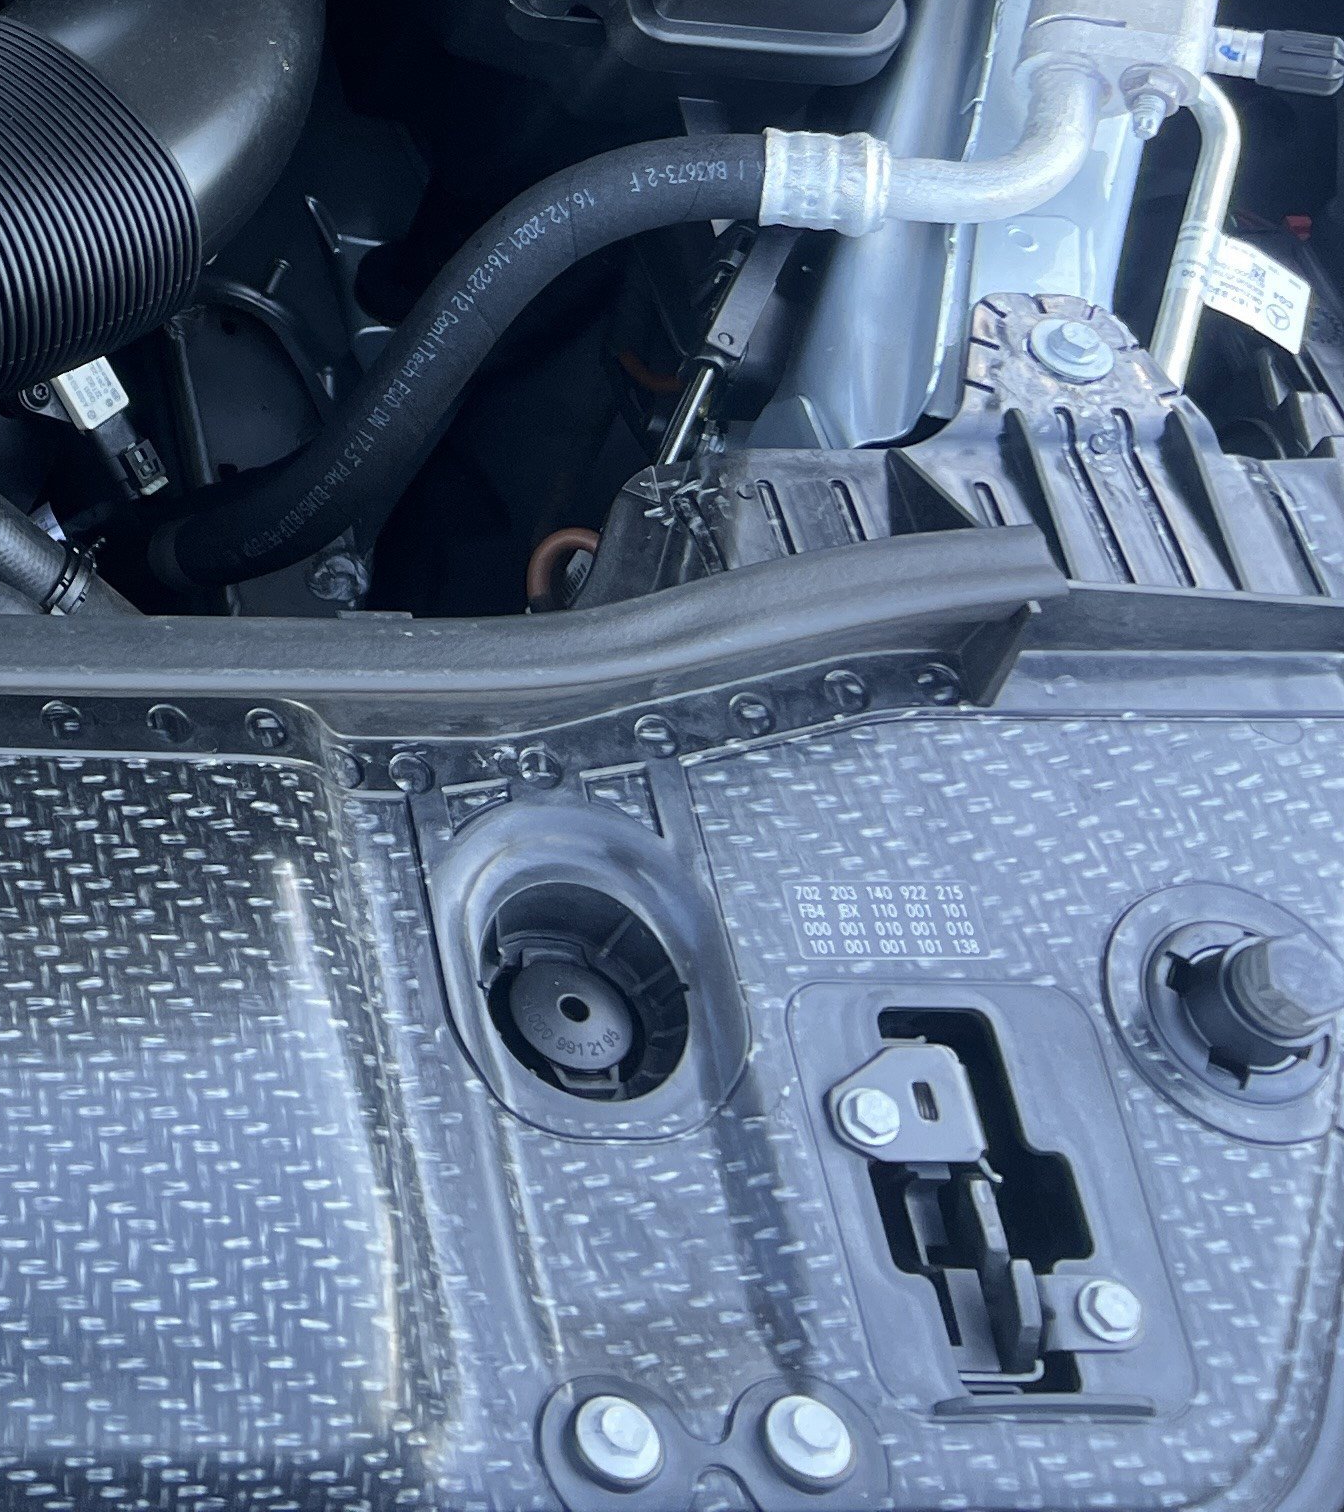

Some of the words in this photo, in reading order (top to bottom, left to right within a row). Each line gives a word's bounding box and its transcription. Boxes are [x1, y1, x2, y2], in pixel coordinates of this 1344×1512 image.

[793, 885, 822, 901] 702
[830, 885, 859, 901] 203
[866, 885, 893, 901] 140
[899, 885, 928, 901] 922
[937, 885, 964, 901] 215
[870, 903, 898, 919] 110
[905, 903, 933, 919] 001
[943, 903, 968, 919] 101
[803, 921, 832, 936] 000
[838, 921, 866, 936] 001
[874, 921, 904, 936] 010
[910, 921, 938, 936] 001
[945, 921, 975, 936] 010
[810, 939, 836, 955] 101
[844, 939, 871, 955] 001
[880, 939, 907, 955] 001
[917, 939, 943, 955] 101
